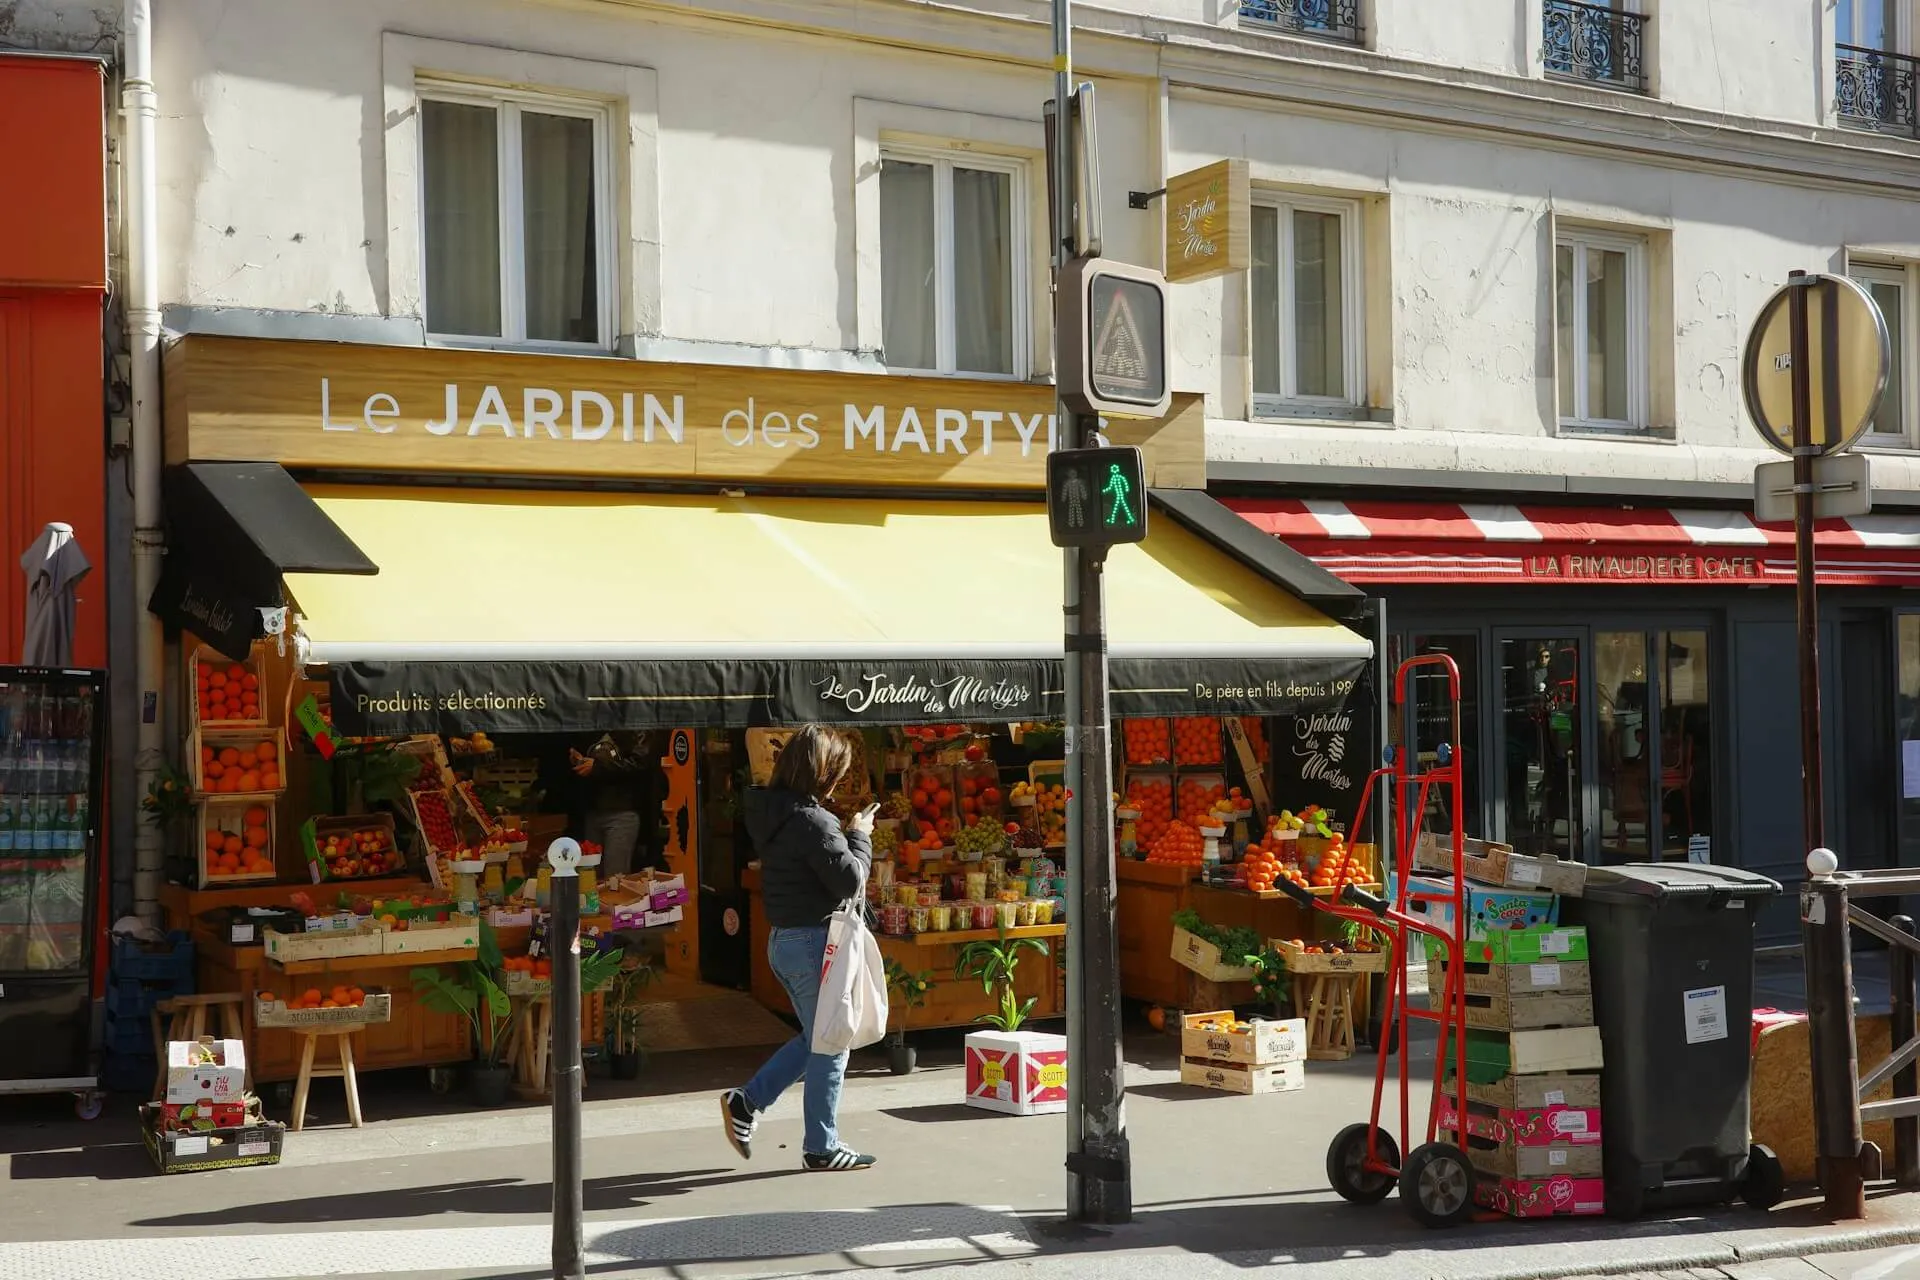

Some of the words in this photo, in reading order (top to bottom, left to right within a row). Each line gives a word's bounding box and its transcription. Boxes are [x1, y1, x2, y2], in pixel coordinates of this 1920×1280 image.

[321, 377, 400, 433] Le
[424, 383, 684, 443] JARDIN
[721, 397, 820, 449] des
[1532, 556, 1560, 575] LA
[1703, 557, 1755, 576] CAFE
[810, 674, 848, 700] Le
[846, 673, 931, 713] Jardin
[930, 675, 1031, 710] Martyrs
[1195, 683, 1213, 699] De
[1216, 684, 1244, 703] père
[1247, 687, 1262, 698] en
[1266, 680, 1283, 697] fils
[1286, 680, 1326, 703] depuis
[357, 689, 432, 713] Produits
[438, 689, 547, 711] sélectionnés
[923, 696, 945, 713] des
[1295, 710, 1352, 740] Jardin
[1291, 744, 1352, 791] Martyrs
[1486, 897, 1530, 919] Santa
[1500, 908, 1526, 920] coco
[1042, 1071, 1064, 1082] SCOTT
